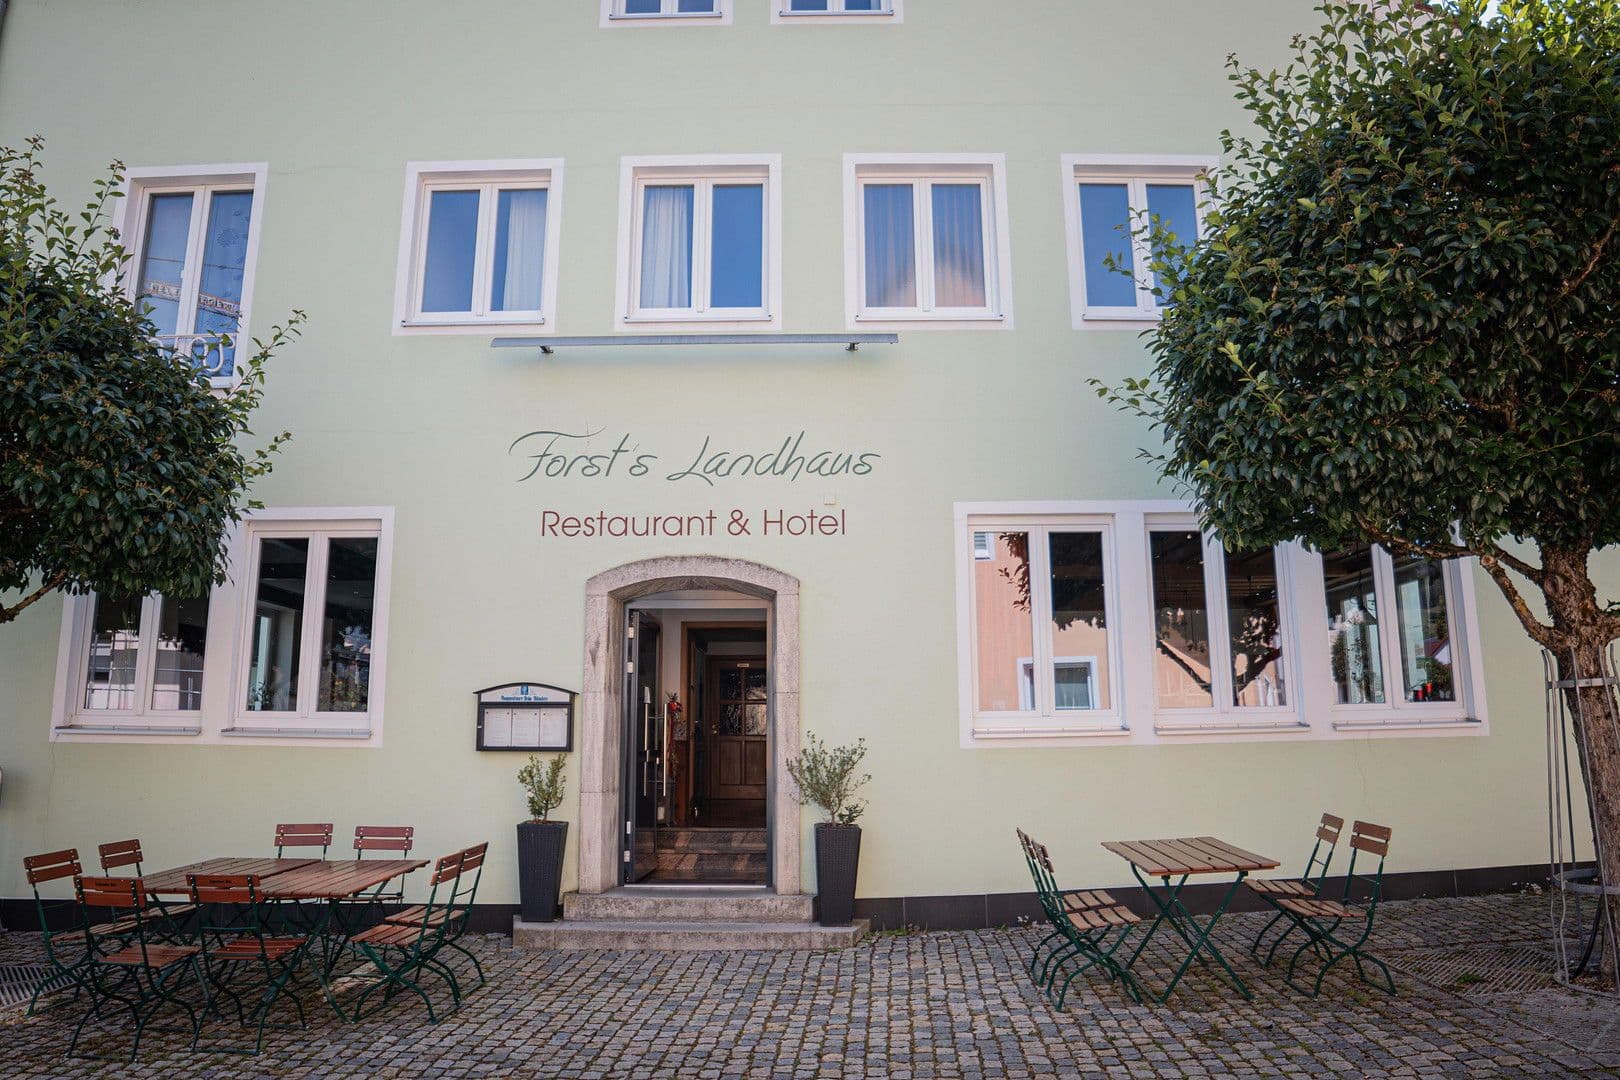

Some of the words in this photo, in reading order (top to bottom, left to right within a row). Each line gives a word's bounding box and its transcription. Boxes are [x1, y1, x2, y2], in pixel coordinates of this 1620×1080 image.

[509, 427, 658, 482] Forst's
[666, 430, 881, 487] Landhaus
[542, 510, 717, 537] Restaurant
[727, 509, 751, 536] &
[764, 509, 845, 536] Hotel
